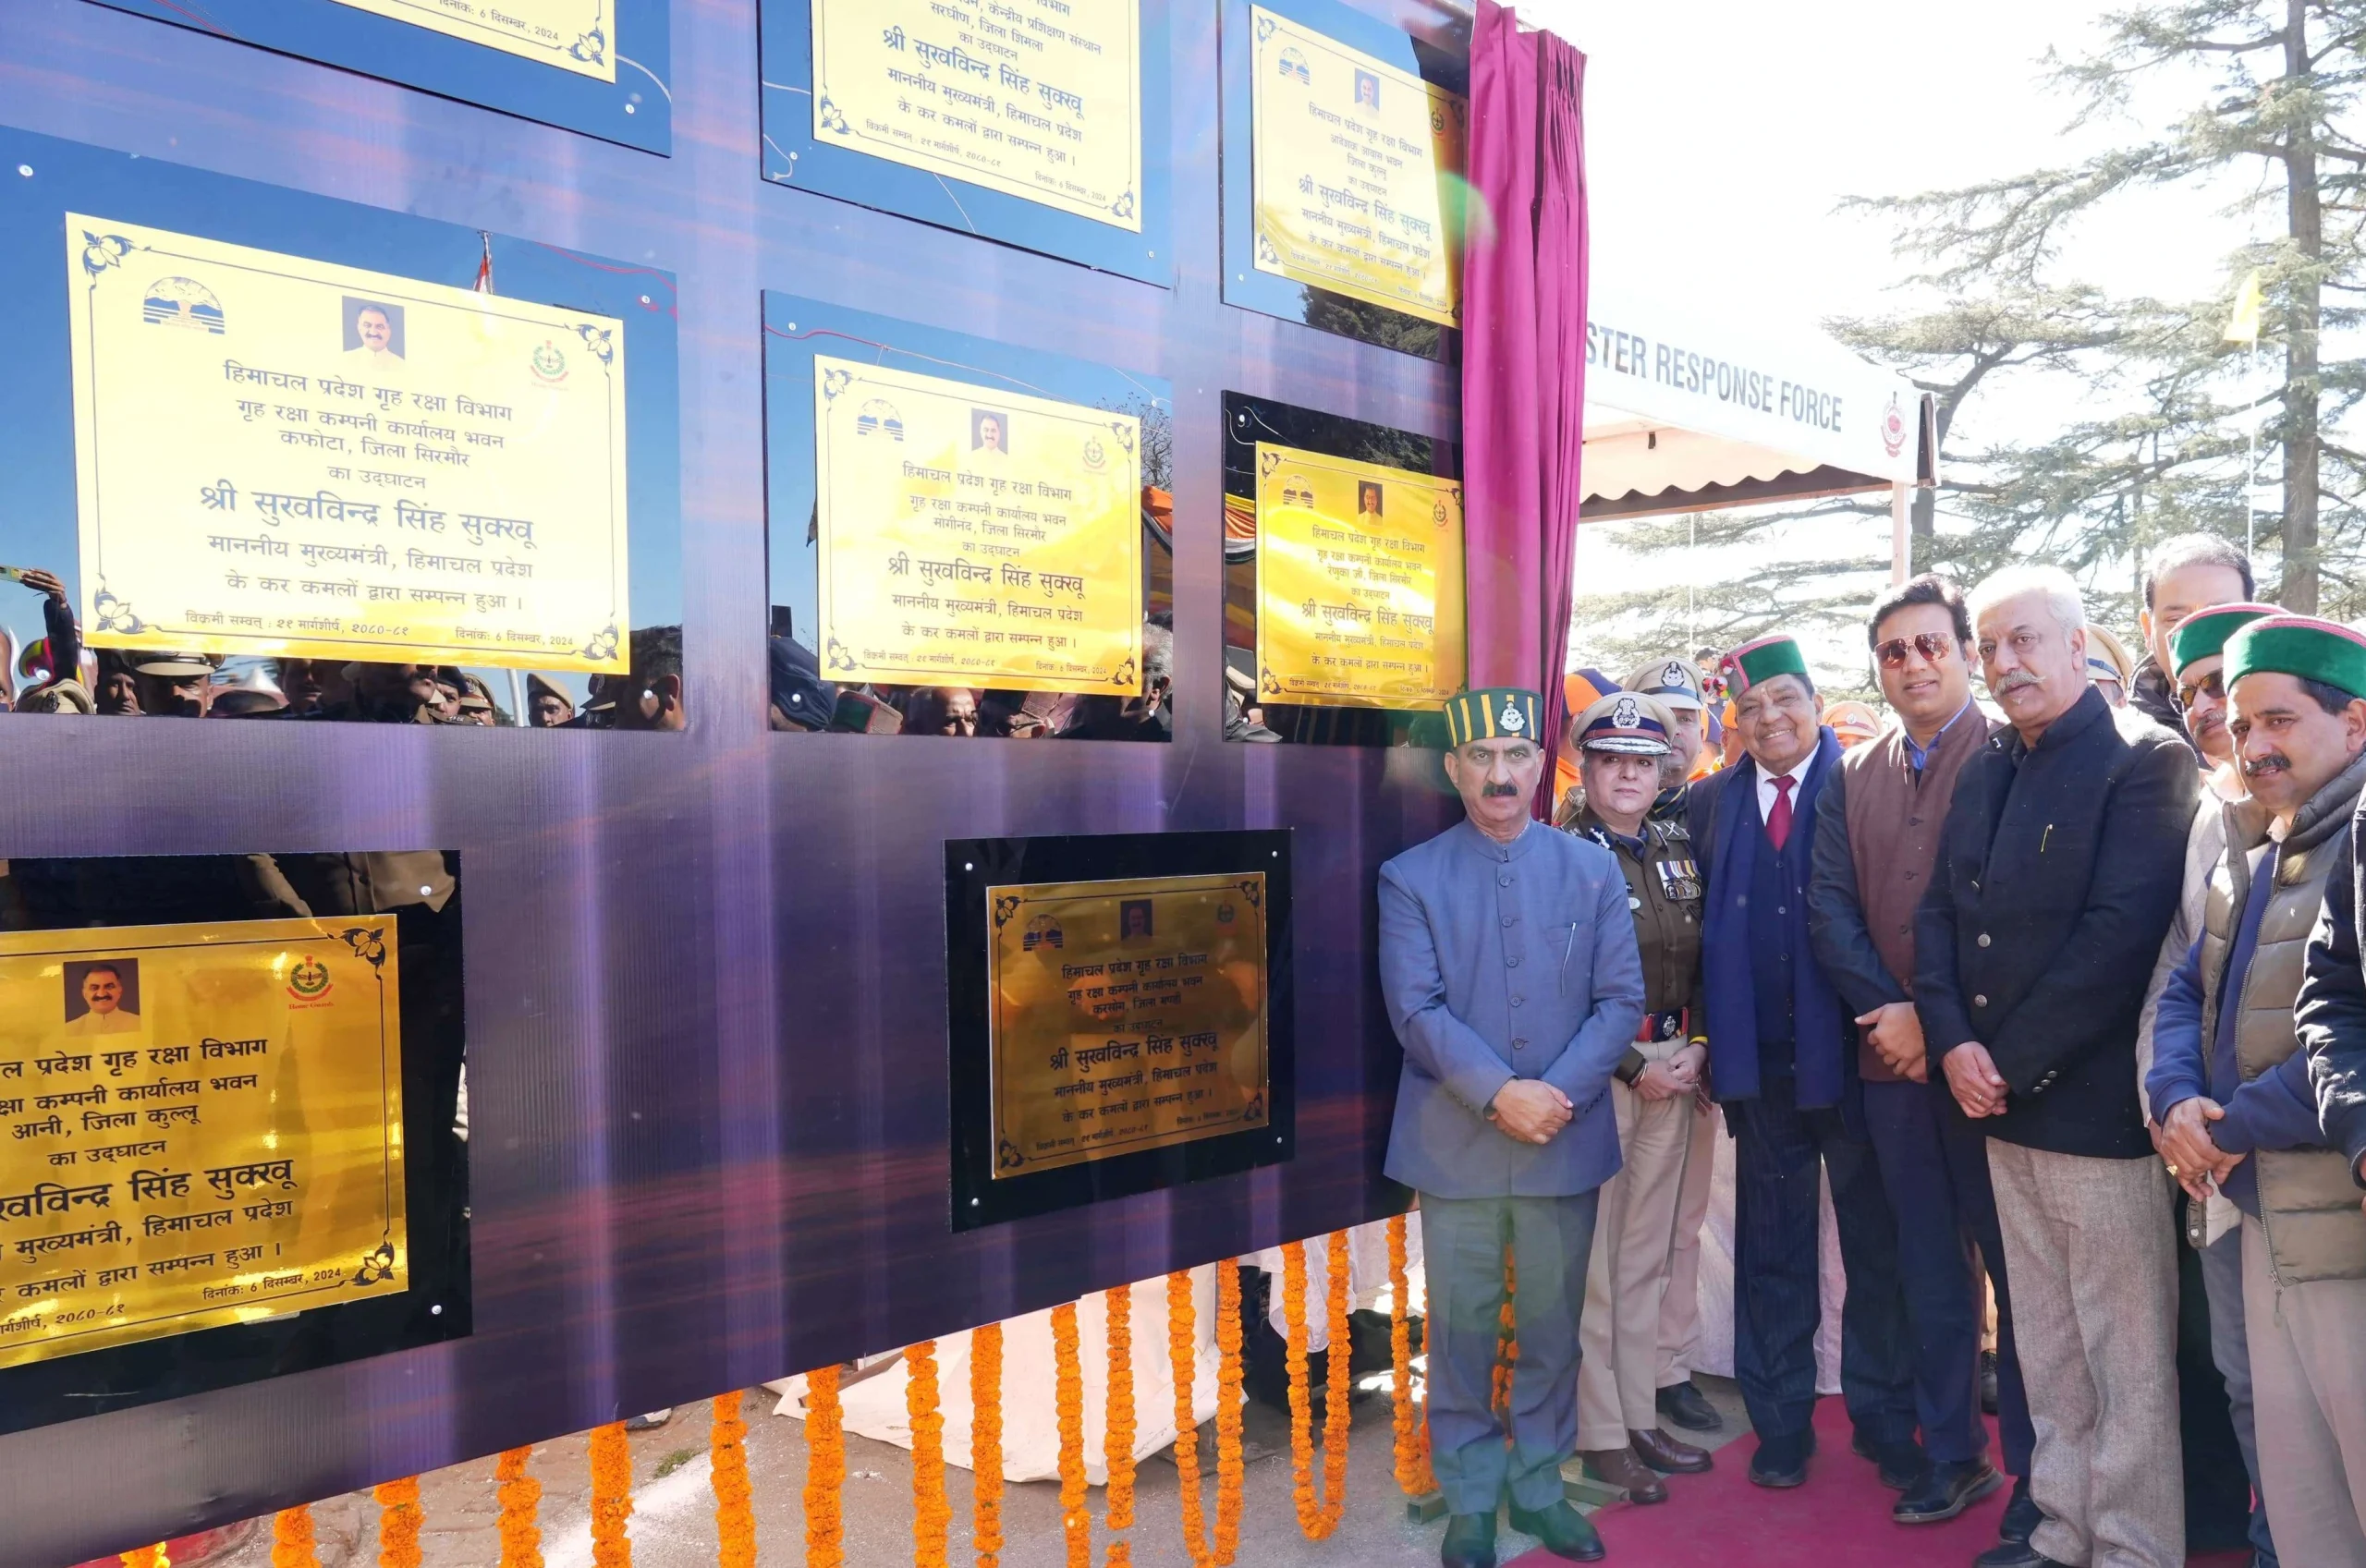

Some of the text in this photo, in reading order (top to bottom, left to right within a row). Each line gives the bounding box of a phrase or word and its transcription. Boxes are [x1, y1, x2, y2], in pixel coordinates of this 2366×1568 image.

[480, 9, 486, 18] 6
[534, 26, 558, 41] 2024
[958, 0, 983, 12] वन,
[223, 359, 512, 421] हिमाचल प्रदेश गृह रक्षा विभाग
[1586, 321, 1843, 433] STER RESPONSE FORCE
[236, 399, 505, 449] गृह रक्षा कम्पनी कार्यालय भवन
[278, 429, 470, 468] कफोटा, जिला सिरमौर
[326, 466, 351, 480] का
[902, 460, 1072, 501] हिमाचल प्रदेश गृह रक्षा विभाग
[200, 479, 537, 550] श्री सुखविन्द्र सिंह सुक्खू
[909, 495, 1067, 527] गृह रक्षा कम्पनी कार्यालय भवन
[933, 513, 1046, 542] मोगीनंद, जिला सिरमौर
[207, 533, 533, 577] माननीय मुख्यमंत्री, हिमाचल प्रदेश
[961, 541, 976, 553] का
[888, 551, 910, 576] श्री
[1000, 563, 1032, 589] सिंह
[225, 568, 507, 614] के कर कमलों द्वारा सम्पन्न हुआ
[891, 591, 940, 610] माननीय
[1006, 600, 1053, 619] हिमाचल
[1056, 609, 1083, 622] प्रदेश
[901, 620, 1067, 651] के कर कमलों द्वारा सम्पन्न हुआ
[33, 1051, 92, 1076] प्रदेश
[100, 1051, 139, 1076] गृह
[146, 1046, 190, 1065] रक्षा
[199, 1038, 268, 1060] विभाग
[0, 1074, 258, 1116] क्षा कम्पनी कार्यालय भवन
[12, 1105, 201, 1139] आनी, जिला कुल्लू
[47, 1140, 167, 1166] का उद्घाटन
[0, 1159, 298, 1222] खविन्द्र सिंह सुक्खू
[14, 1220, 132, 1264] मुख्यमंत्री,
[141, 1209, 234, 1237] हिमाचल
[242, 1197, 293, 1222] प्रदेश
[15, 1269, 87, 1297] कमलों
[96, 1266, 139, 1287] द्वारा
[146, 1253, 215, 1276] सम्पन्न
[224, 1245, 263, 1270] हुआ
[202, 1267, 341, 1300] दिनांक: 6 दिसम्बर, 2024
